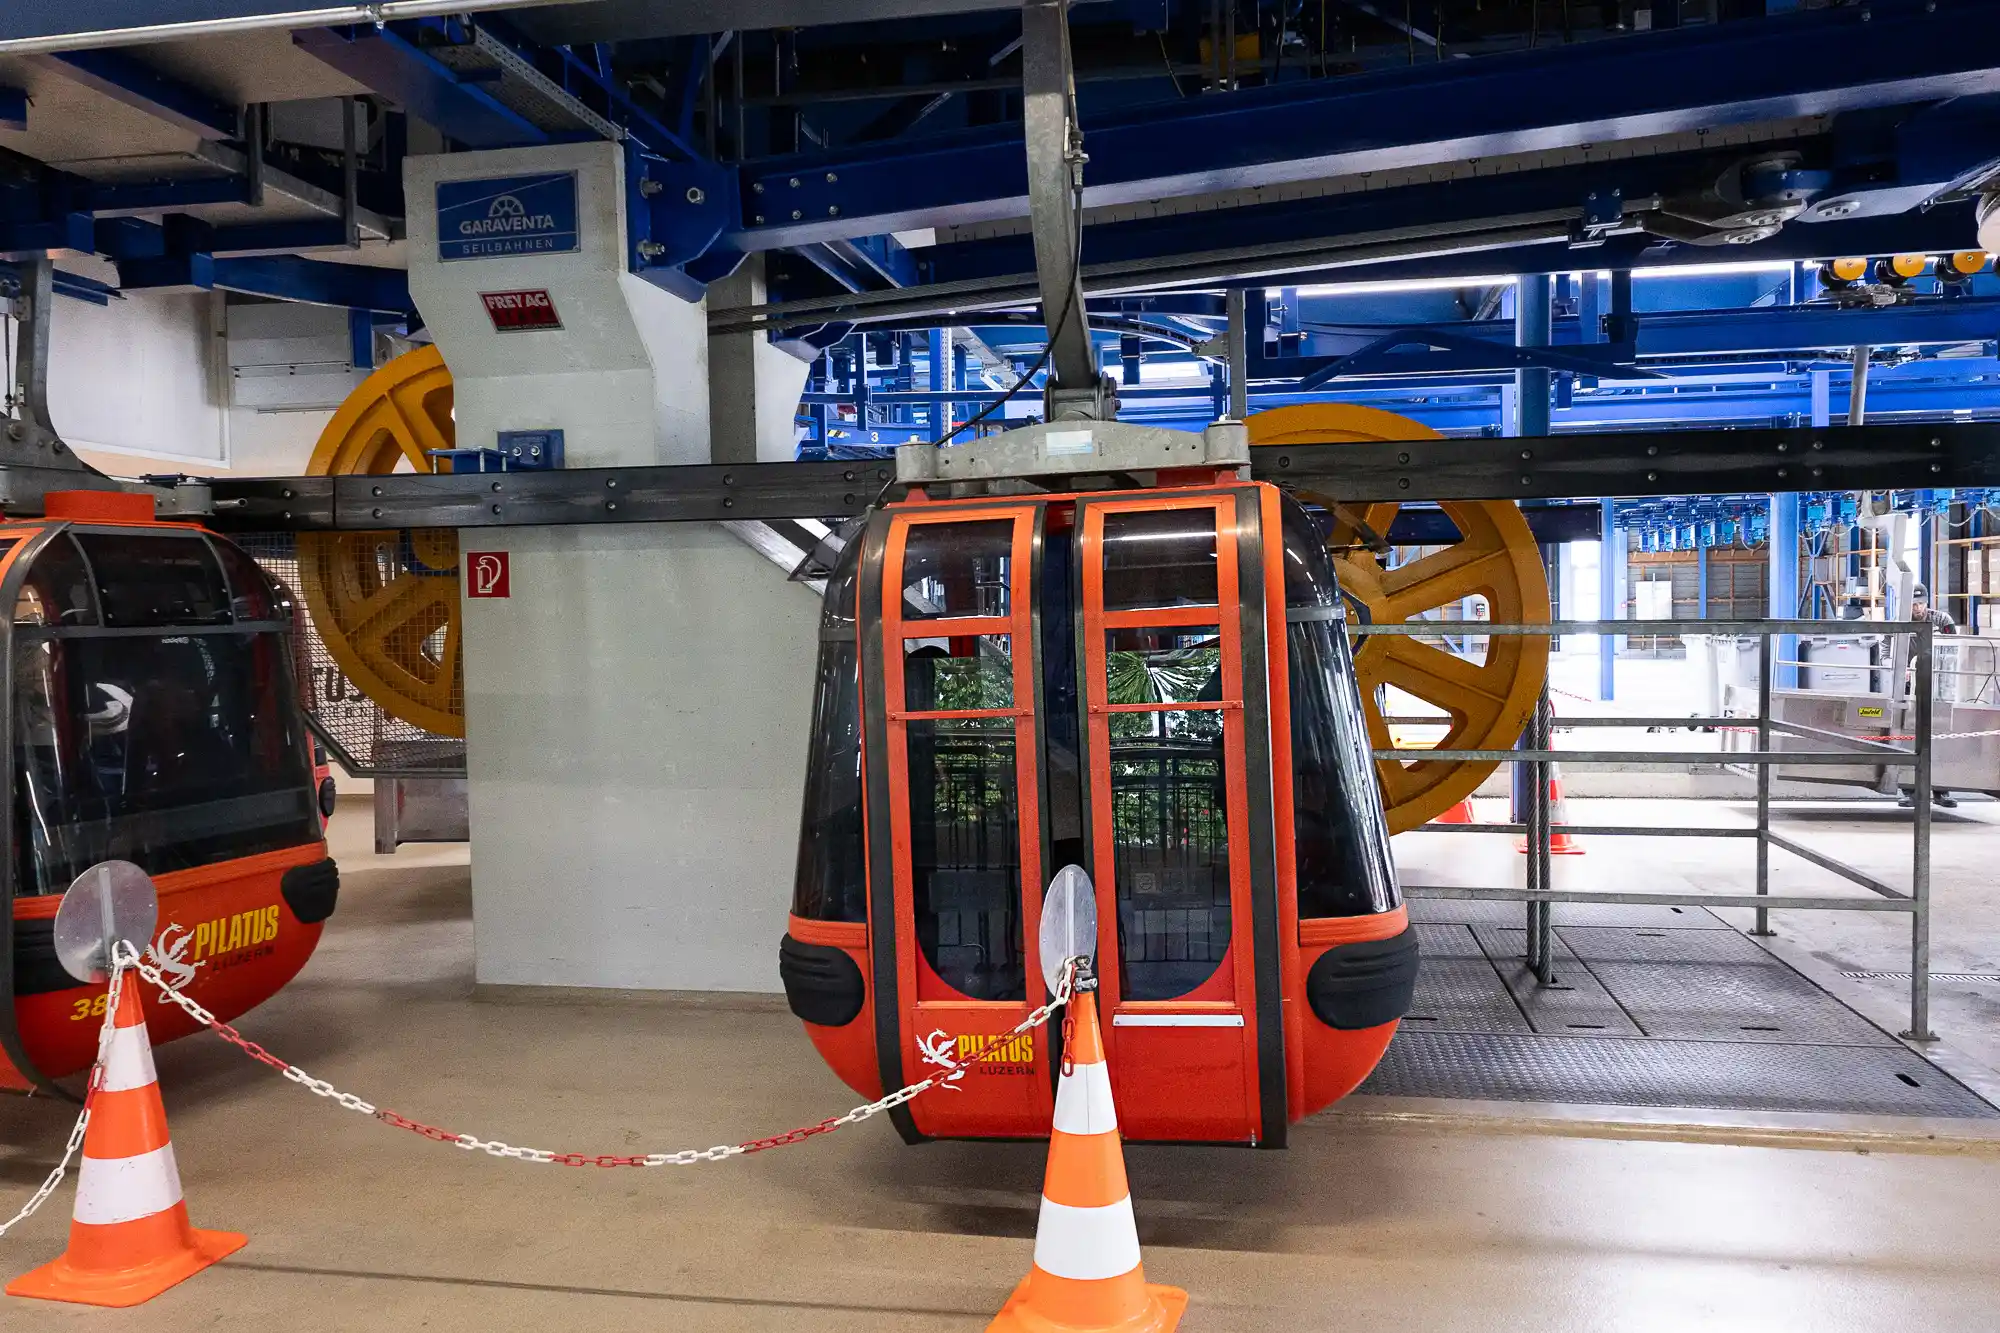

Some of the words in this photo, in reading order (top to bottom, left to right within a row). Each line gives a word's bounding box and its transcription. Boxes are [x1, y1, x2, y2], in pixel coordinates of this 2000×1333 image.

[459, 215, 554, 235] GARAVENTA
[462, 239, 553, 255] SEILBAHNEN
[484, 294, 523, 310] FREY
[525, 293, 549, 308] AG
[870, 431, 879, 443] 3
[194, 904, 279, 960] PILATUS
[70, 993, 108, 1021] 38
[979, 1066, 1035, 1075] LUZERN
